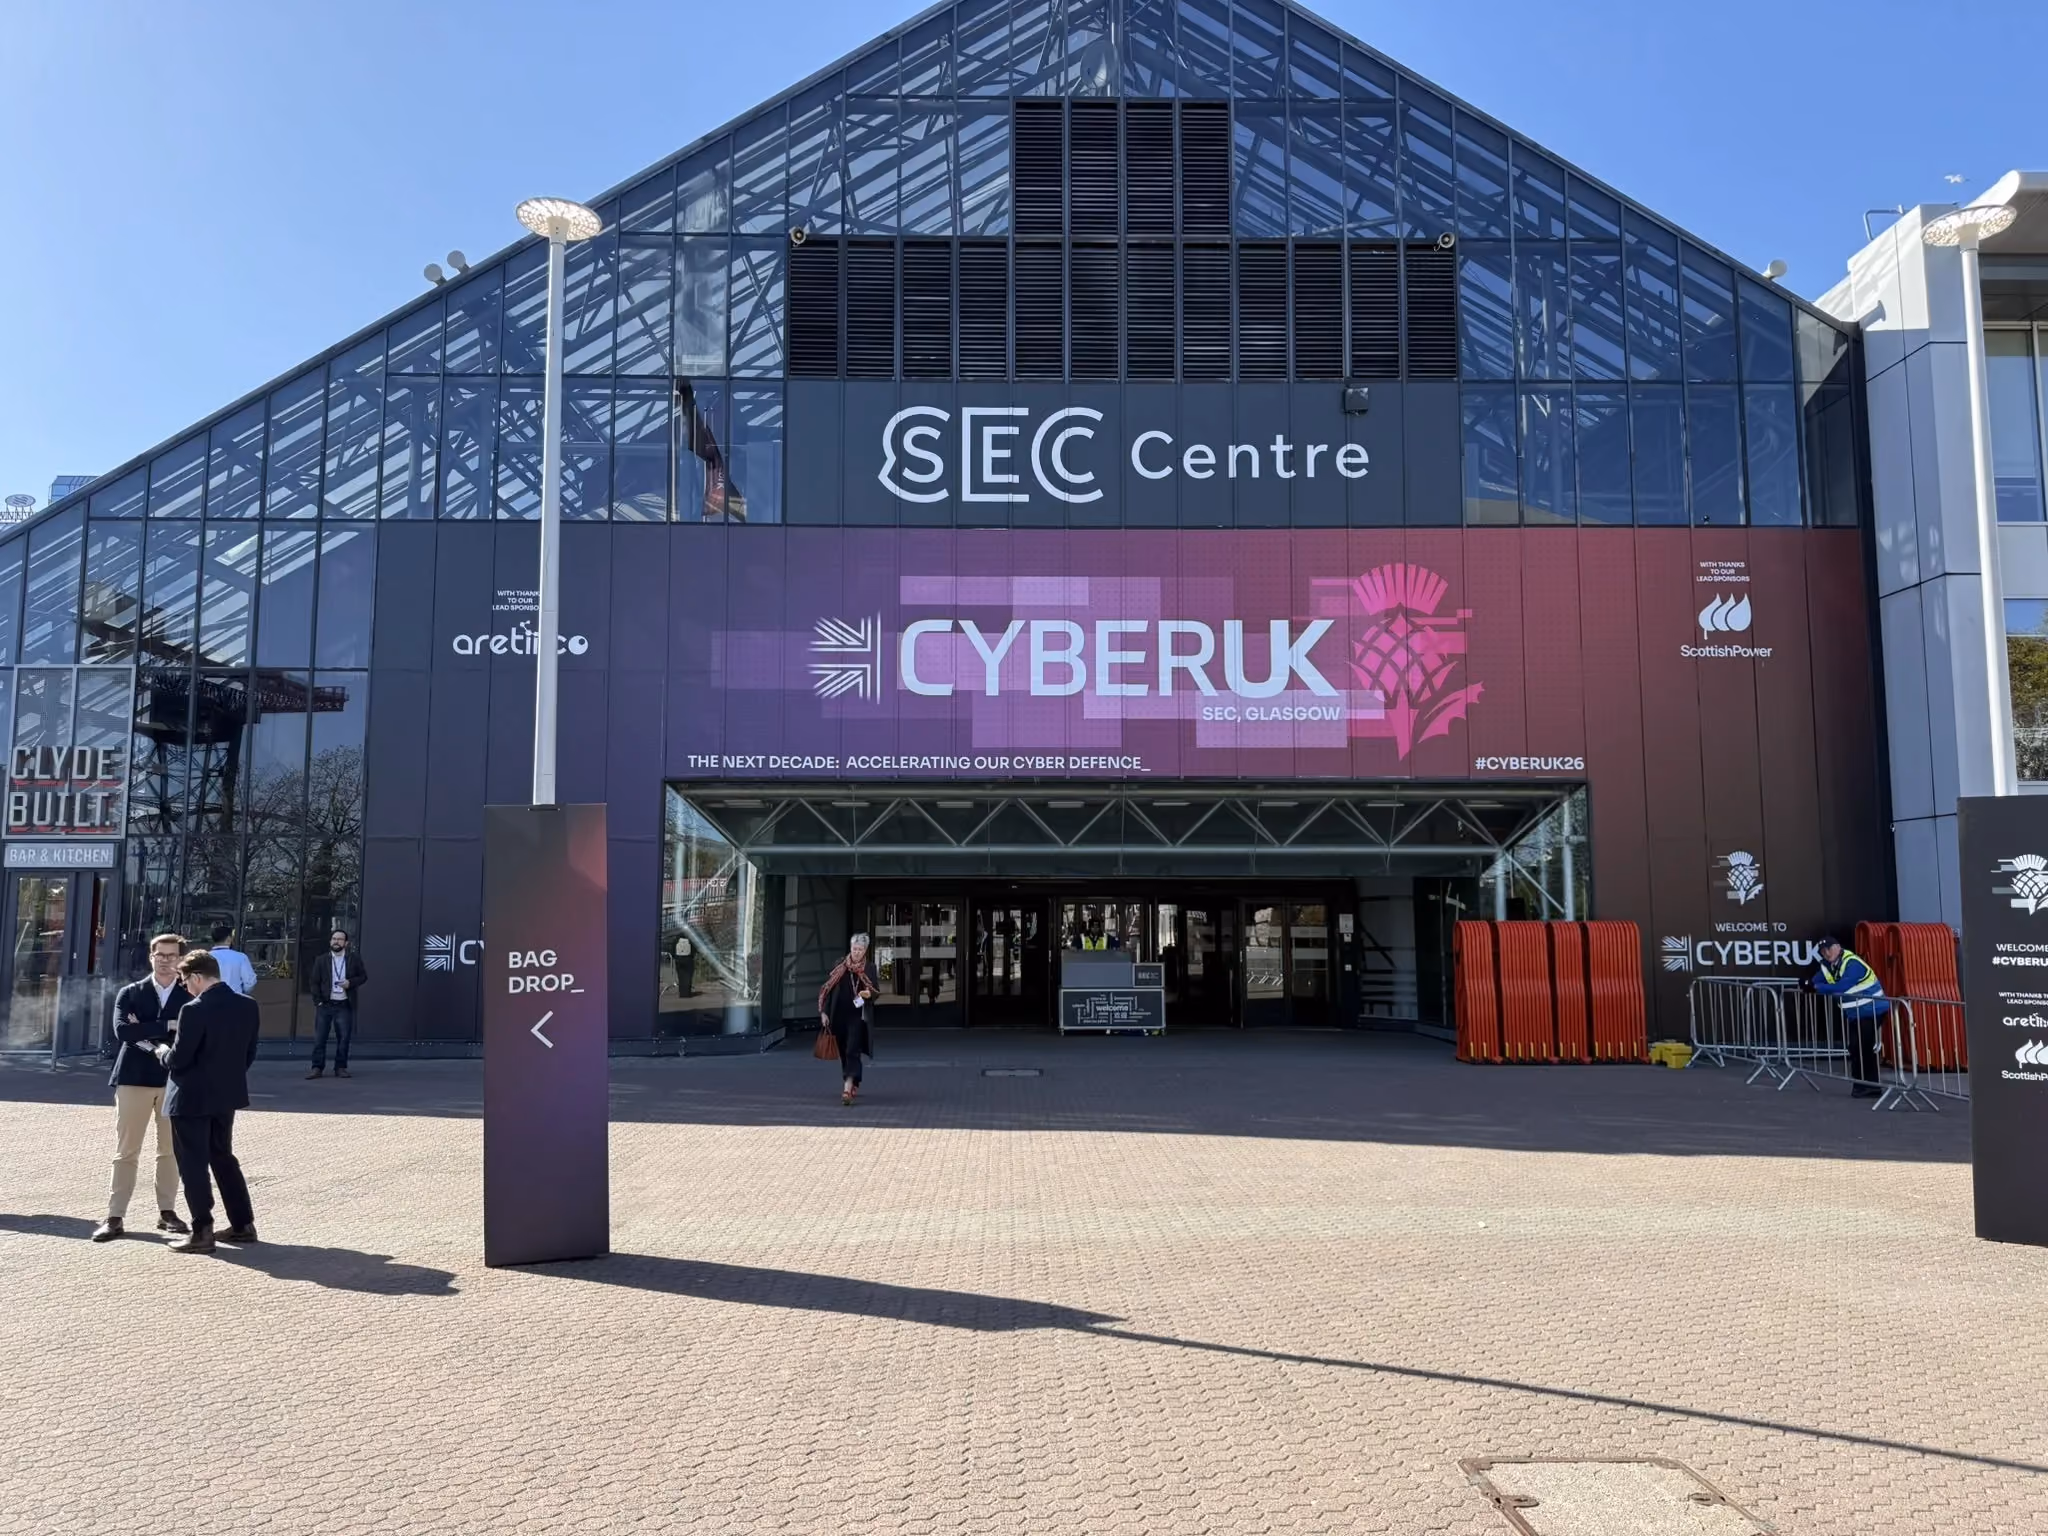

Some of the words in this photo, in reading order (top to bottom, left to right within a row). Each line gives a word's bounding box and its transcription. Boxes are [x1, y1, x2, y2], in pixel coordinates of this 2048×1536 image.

[878, 406, 1104, 503] SEC
[1131, 430, 1370, 480] Centre
[1680, 645, 1772, 657] ScottishPower
[901, 619, 1340, 699] CYBERUK
[1202, 706, 1241, 723] SEC,
[1245, 706, 1340, 721] GLASGOW
[11, 746, 115, 780] CLYDE
[688, 755, 719, 768] THE
[722, 755, 766, 768] NEXT
[769, 756, 840, 769] DECADE:
[846, 756, 971, 769] ACCELERATING
[974, 756, 1010, 769] OUR
[1013, 756, 1065, 769] CYBER
[1069, 756, 1151, 771] DEFENCE_
[1475, 757, 1585, 770] #CYBERUK26
[10, 849, 36, 862] BAR
[39, 849, 48, 862] &
[54, 849, 110, 862] KITCHEN
[1715, 923, 1768, 932] WELCOME
[1773, 923, 1787, 932] TO
[1696, 940, 1823, 966] CYBERUK
[1996, 944, 2048, 953] WELCOME
[508, 949, 557, 969] BAG
[1096, 1003, 1129, 1012] welcome
[2001, 1070, 2048, 1081] ScottishP
